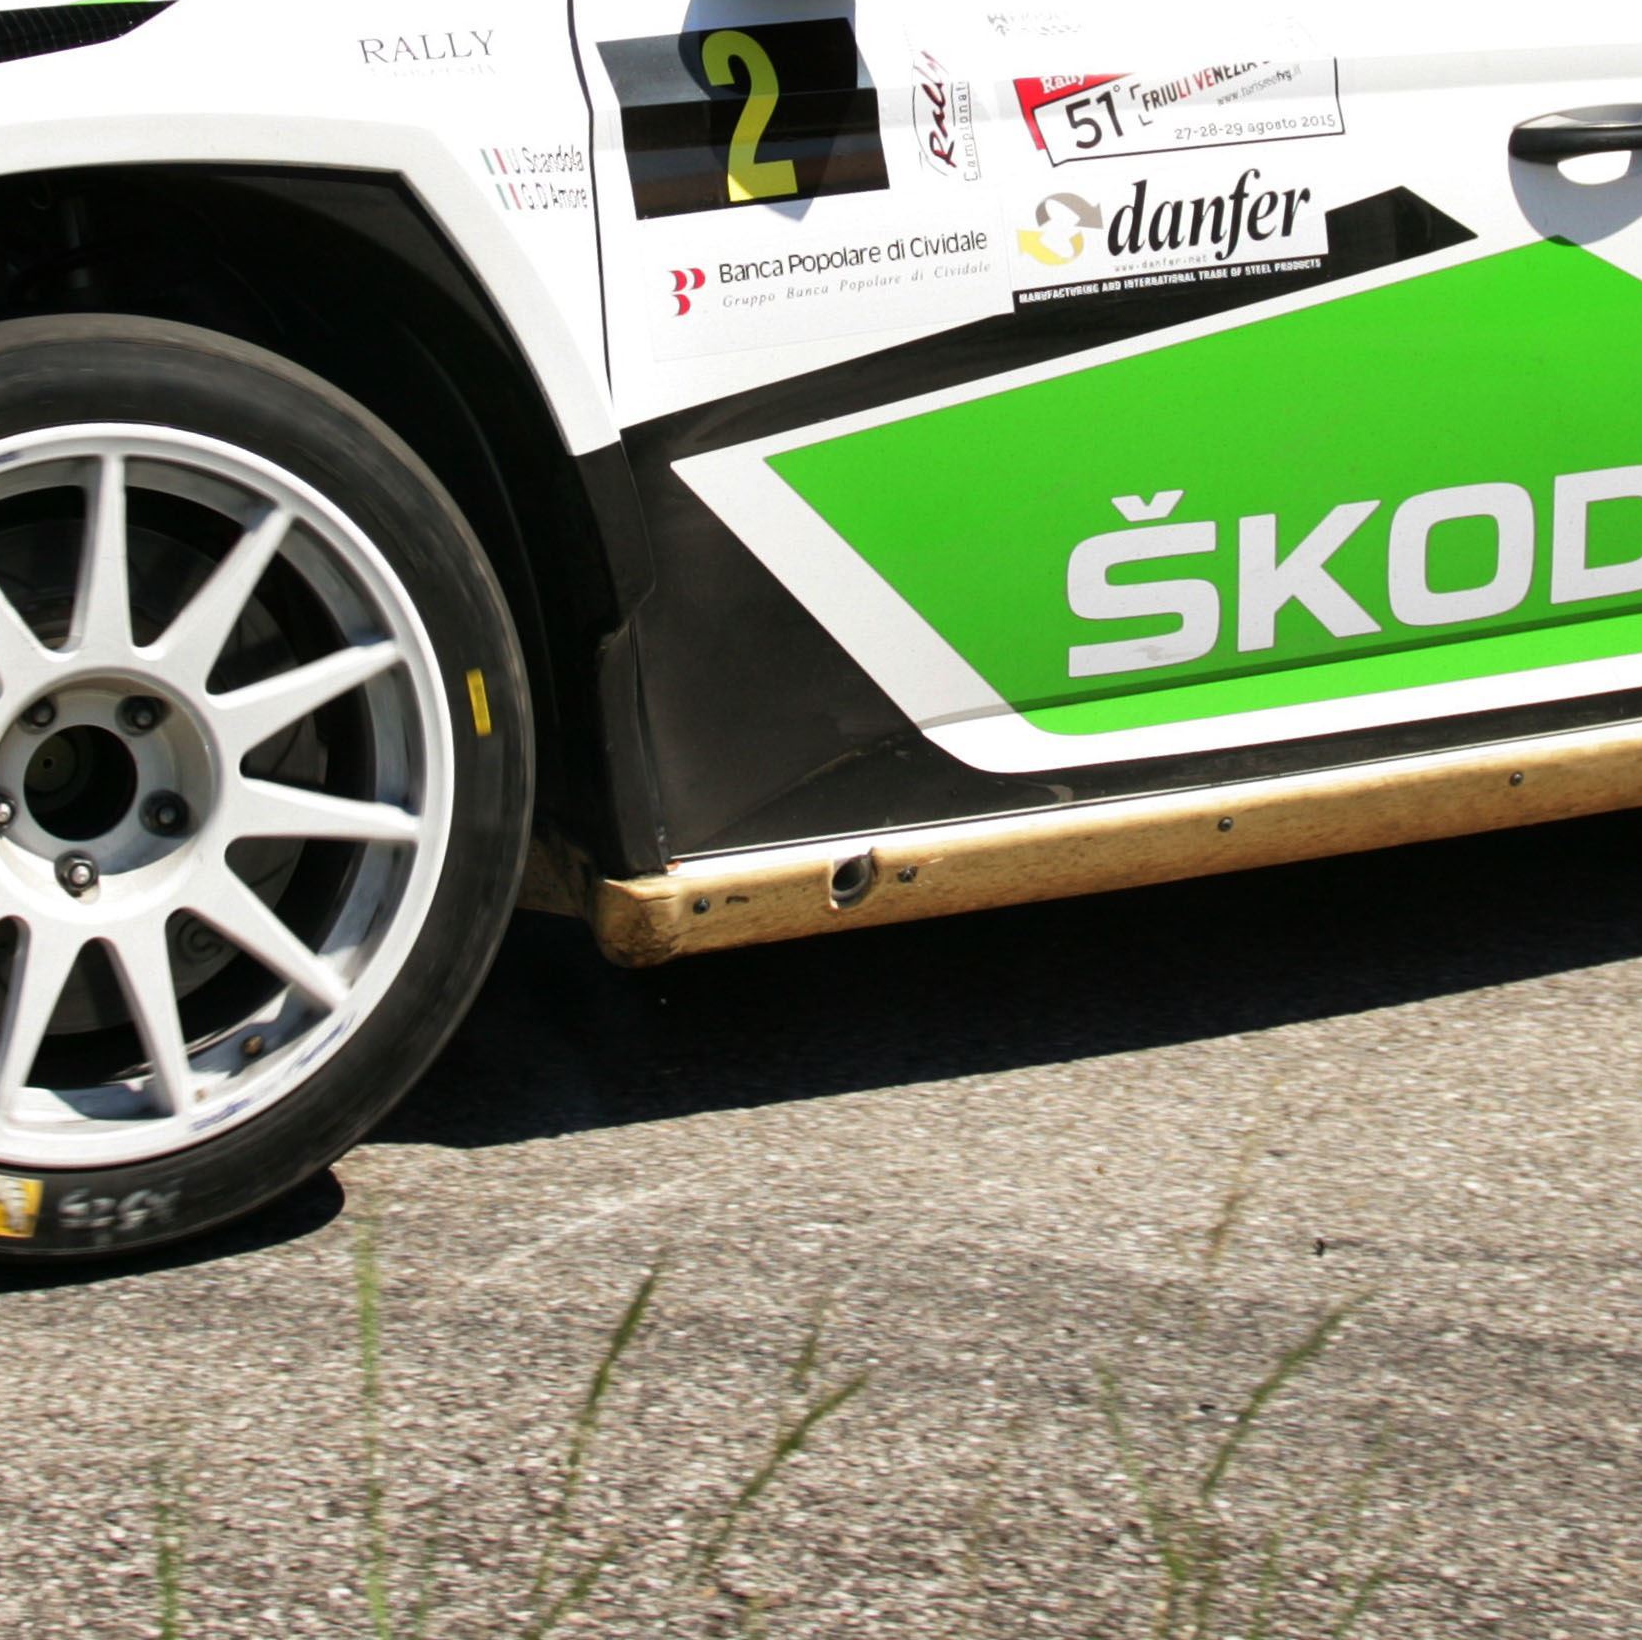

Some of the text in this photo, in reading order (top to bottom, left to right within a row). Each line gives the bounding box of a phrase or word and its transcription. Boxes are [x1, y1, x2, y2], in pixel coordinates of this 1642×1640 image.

[358, 30, 494, 64] RALLY
[701, 29, 798, 201] 2
[1141, 81, 1192, 113] FRIULI
[956, 81, 979, 182] Campionat
[1175, 113, 1336, 141] 27-28-29 agosto 2015
[1107, 168, 1310, 261] danfer
[719, 230, 988, 284] Banca Popolare di Cividale
[1019, 257, 1322, 304] MANUFACTURING AND INTERNATIONAL TRADE OF STEEL PRODUCTS
[722, 260, 992, 311] Gruppo Banca Popolare di Cividale
